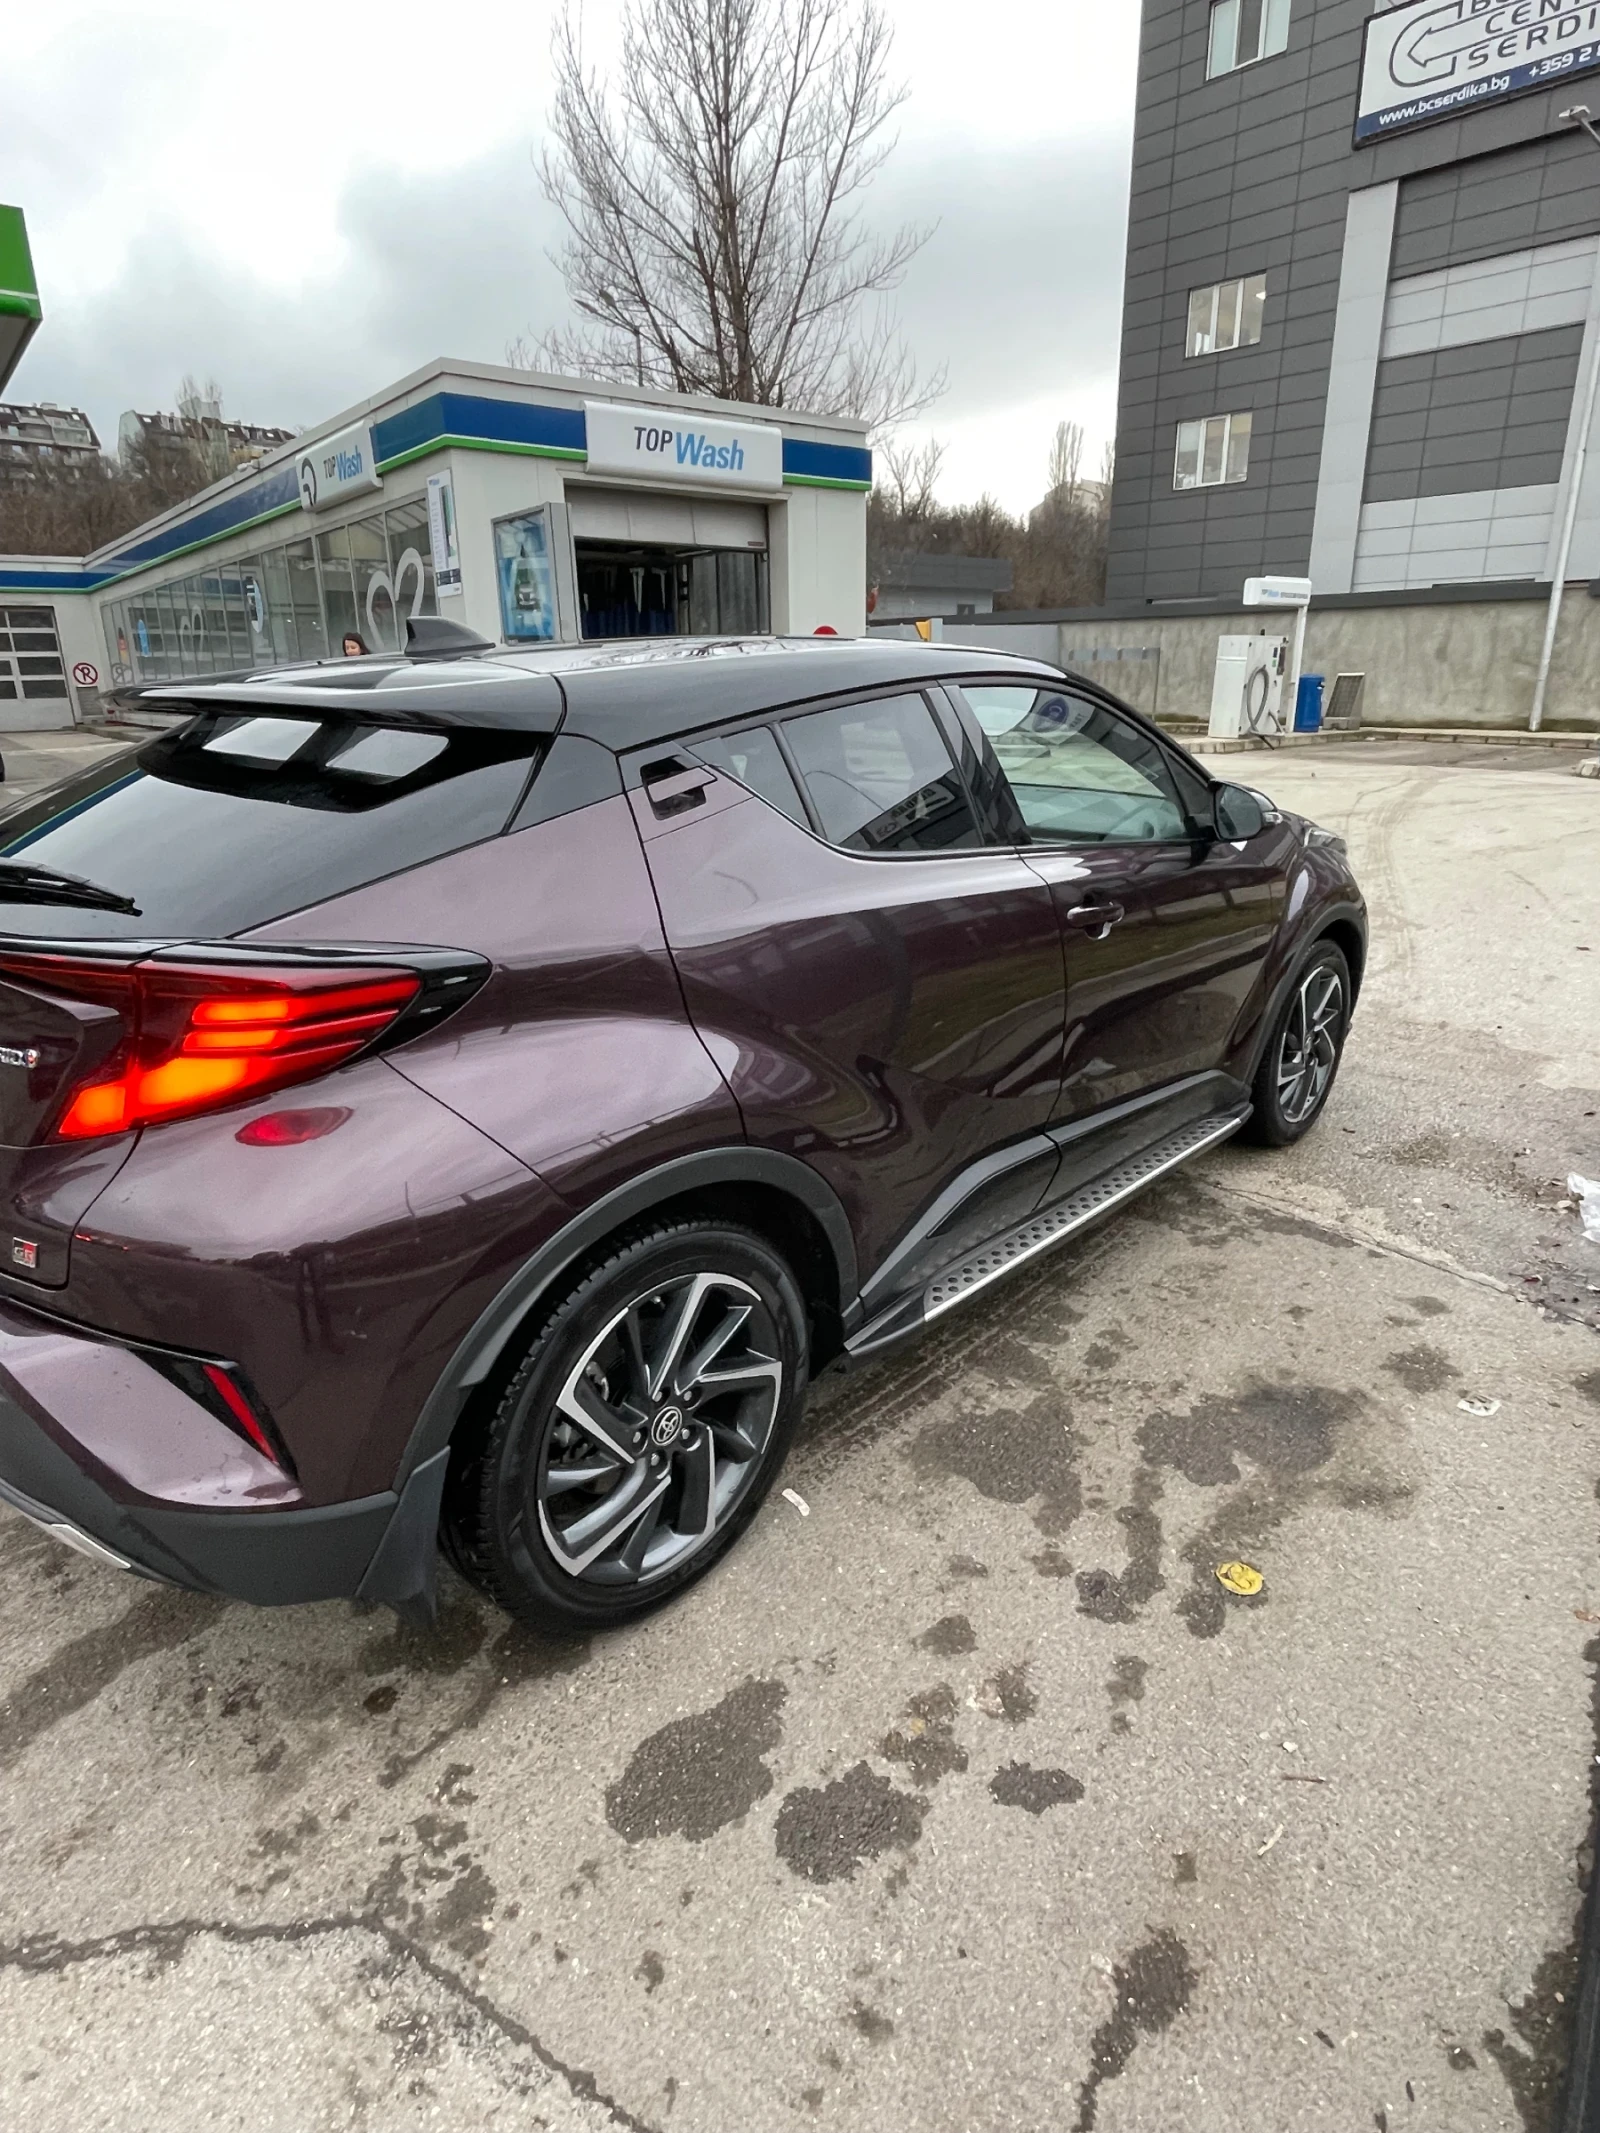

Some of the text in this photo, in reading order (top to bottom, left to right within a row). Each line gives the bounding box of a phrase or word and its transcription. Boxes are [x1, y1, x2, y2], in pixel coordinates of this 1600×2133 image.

[1485, 0, 1581, 34] CEN
[1529, 53, 1574, 77] +359
[1579, 47, 1592, 62] 2
[1379, 75, 1510, 125] www.bcserdika.bg
[323, 445, 363, 482] TOP Wash
[634, 426, 744, 470] TOP Wash
